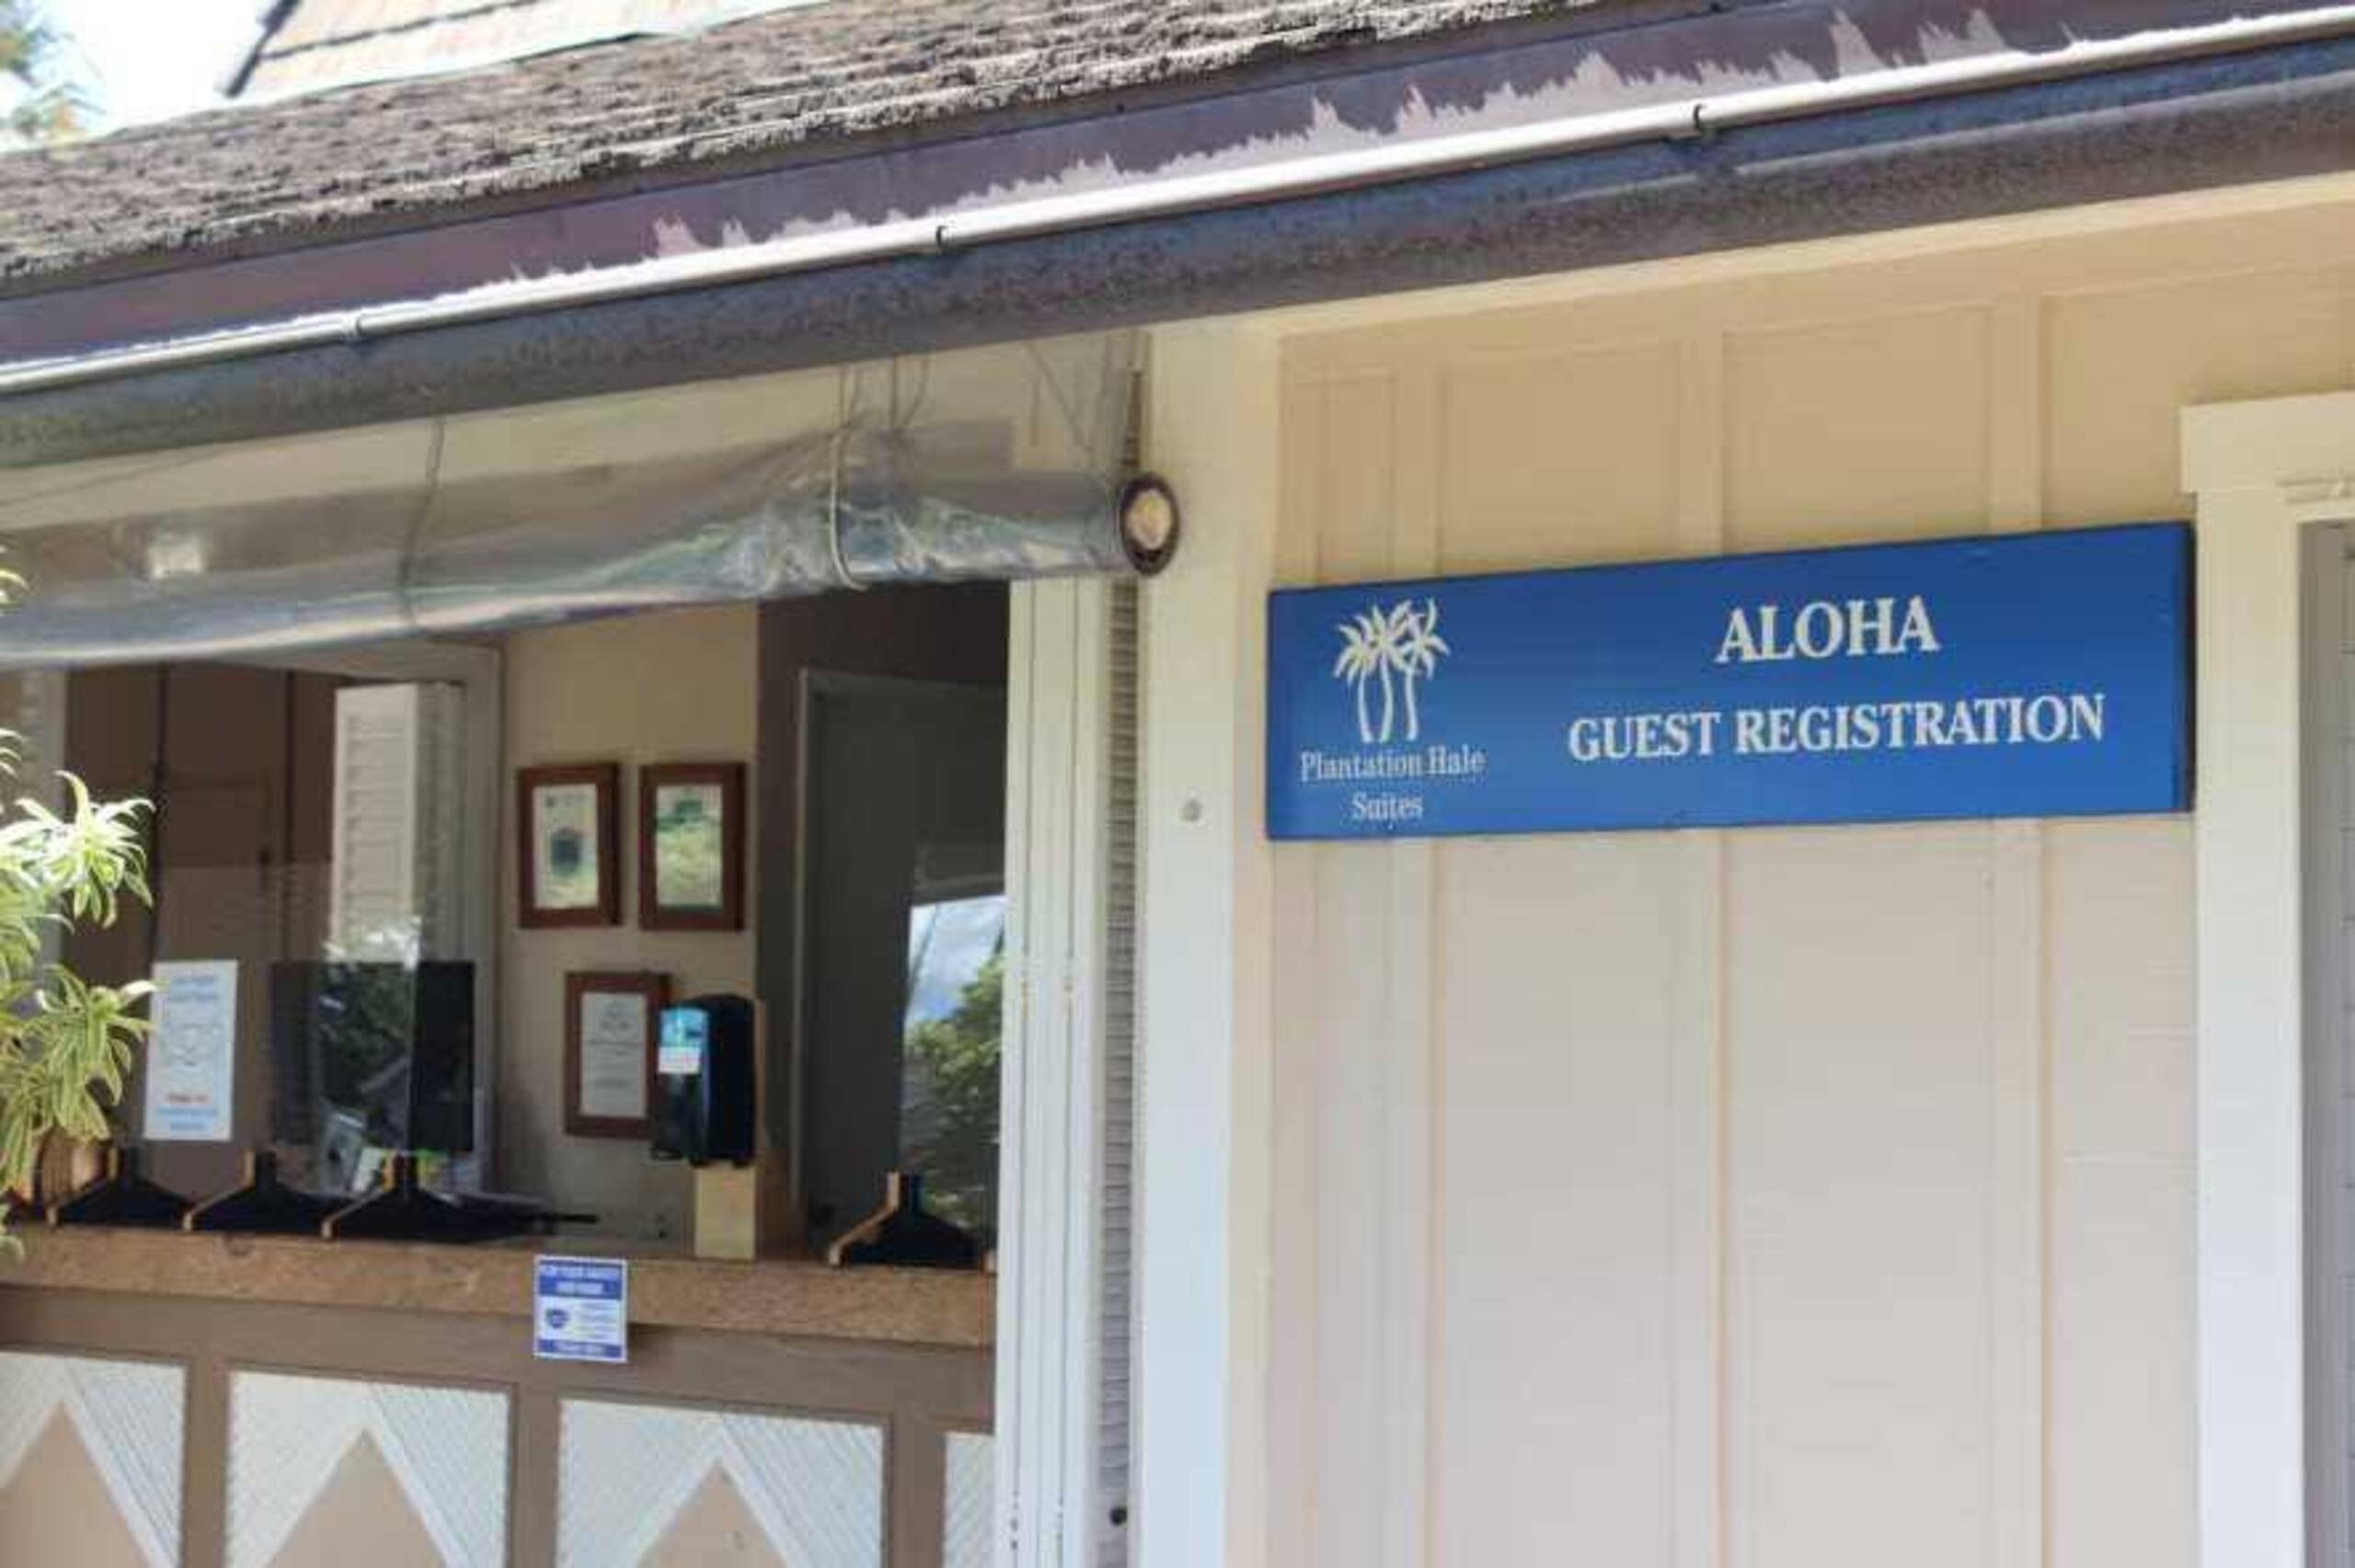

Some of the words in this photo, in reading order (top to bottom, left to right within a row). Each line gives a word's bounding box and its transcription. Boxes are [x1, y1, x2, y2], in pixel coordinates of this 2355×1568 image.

[1716, 595, 1940, 664] ALOHA
[1568, 711, 1722, 763] GUEST
[1735, 692, 2106, 756] REGISTRATION
[1300, 750, 1423, 782] Plantation
[1428, 743, 1487, 776] Hale
[1351, 791, 1424, 821] Suites
